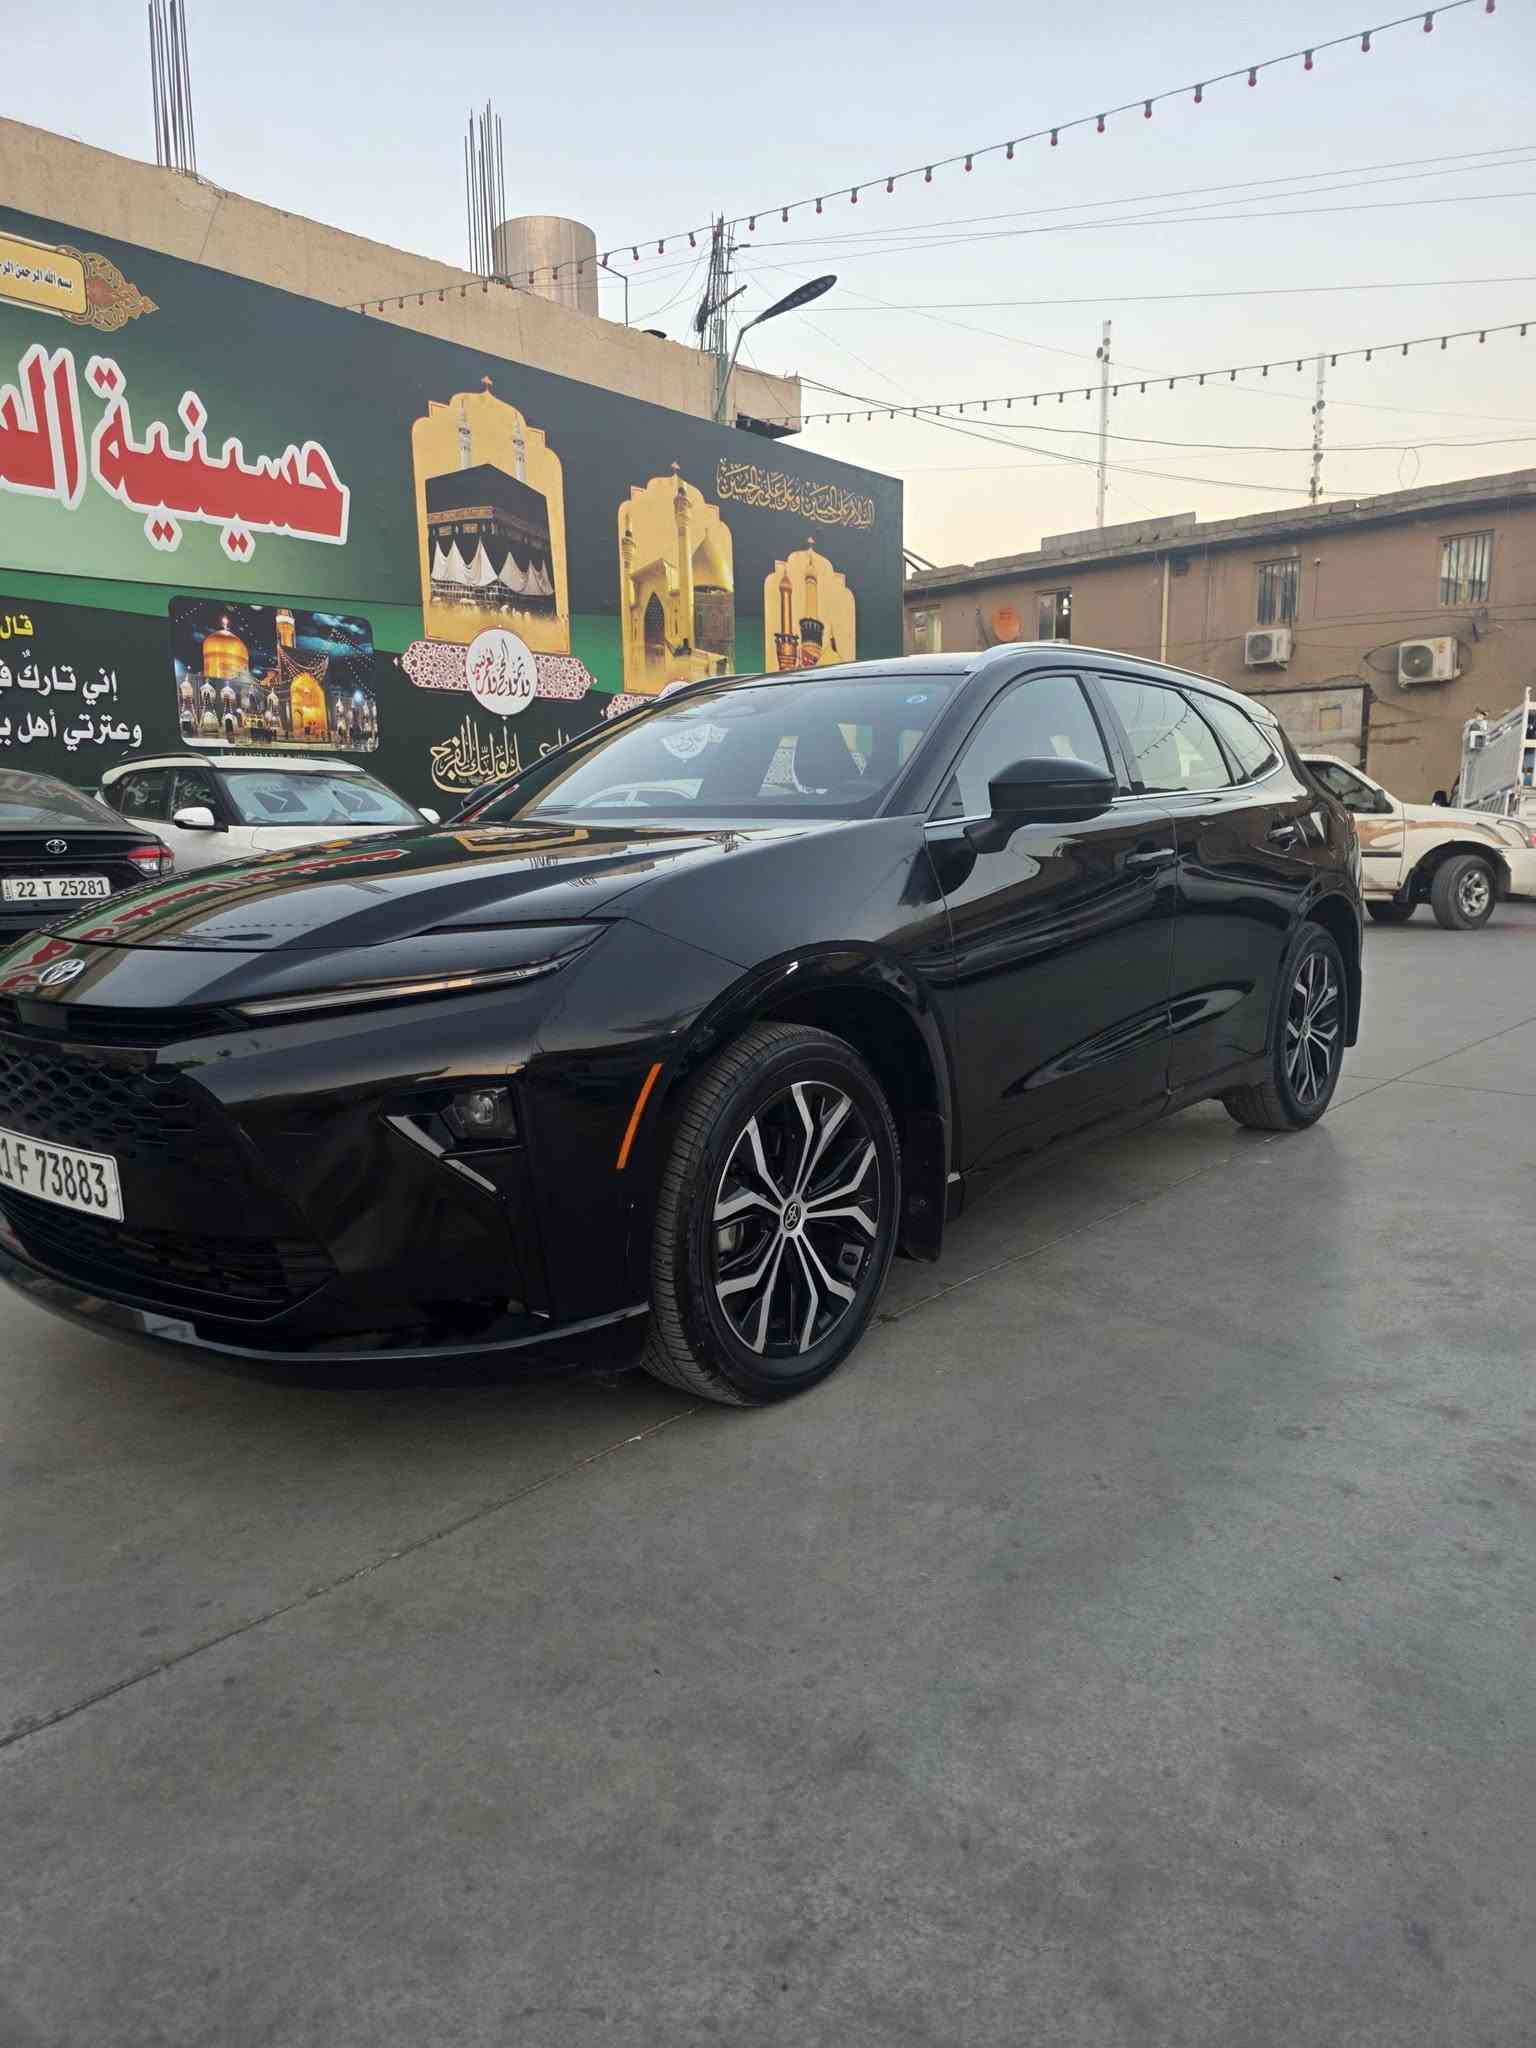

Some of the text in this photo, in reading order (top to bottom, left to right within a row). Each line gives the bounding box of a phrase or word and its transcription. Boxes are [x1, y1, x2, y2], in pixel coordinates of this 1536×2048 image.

[15, 263, 43, 283] الرحمن
[44, 271, 57, 285] الله
[57, 277, 73, 294] بسم
[86, 356, 350, 562] حسينية
[0, 613, 34, 640] قال
[82, 666, 119, 705] إني
[17, 708, 57, 744] أهل
[16, 881, 37, 898] 22
[43, 880, 52, 897] T
[59, 879, 106, 897] 25281
[16, 1141, 29, 1185] F
[34, 1147, 108, 1209] 73883
